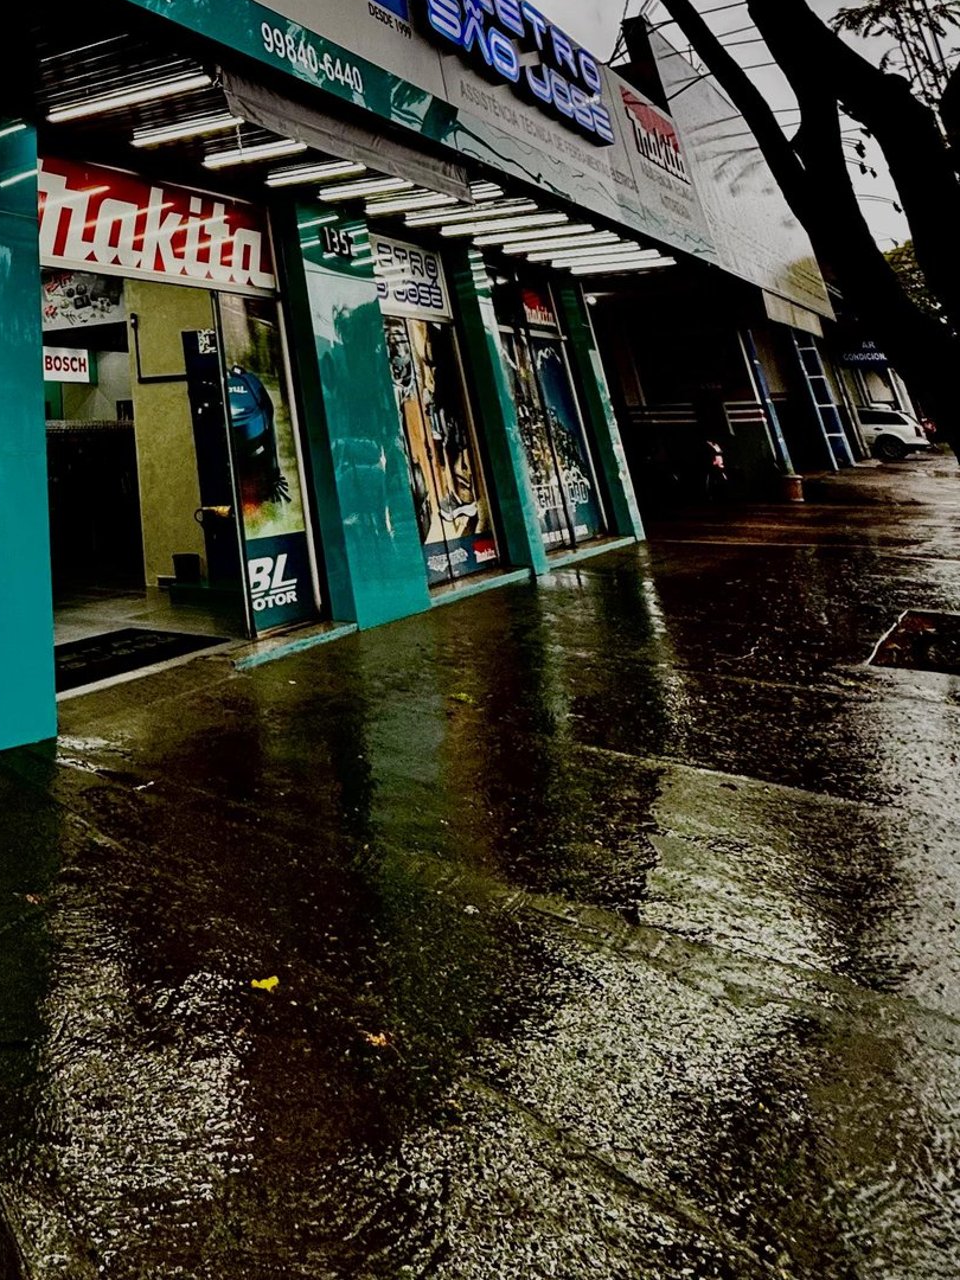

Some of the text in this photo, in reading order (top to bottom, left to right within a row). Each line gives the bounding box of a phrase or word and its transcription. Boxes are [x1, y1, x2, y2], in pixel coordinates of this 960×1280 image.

[368, 1, 412, 39] DESDE 1999
[261, 22, 363, 94] 99840-6440
[44, 355, 87, 373] BOSCH
[248, 553, 298, 593] BL
